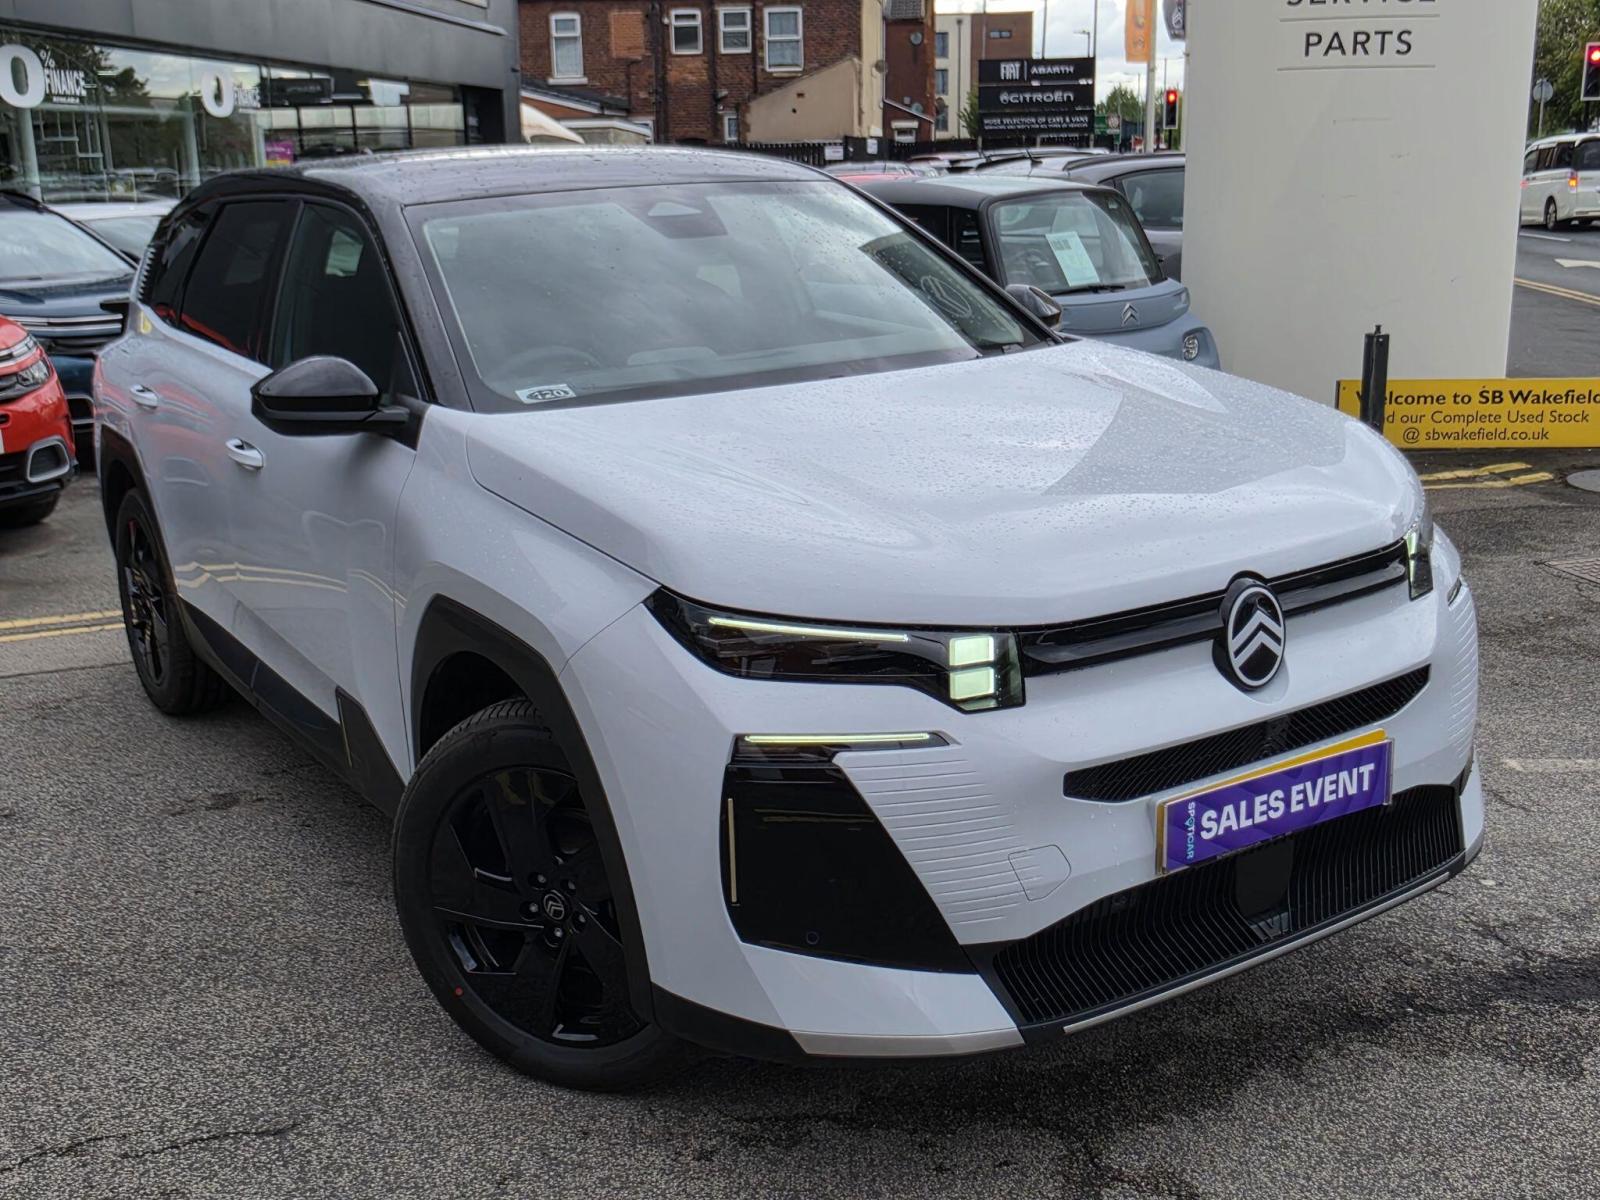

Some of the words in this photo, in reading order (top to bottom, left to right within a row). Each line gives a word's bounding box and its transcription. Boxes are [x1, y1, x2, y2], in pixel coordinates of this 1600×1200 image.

[1304, 29, 1413, 57] PARTS
[1001, 61, 1020, 80] FIAT
[1031, 65, 1074, 75] ABARTH
[44, 67, 87, 97] FINANCE
[1356, 391, 1447, 405] lcome
[1453, 391, 1472, 405] to
[1478, 389, 1504, 405] SB
[1400, 414, 1426, 424] our
[1431, 410, 1502, 426] Complete
[1507, 410, 1544, 424] Used
[1549, 410, 1590, 424] Stock
[1425, 427, 1550, 441] sbwakefield.co.uk
[1200, 789, 1286, 840] SALES
[1290, 763, 1375, 813] EVENT
[1185, 801, 1196, 860] SPOTICAR
